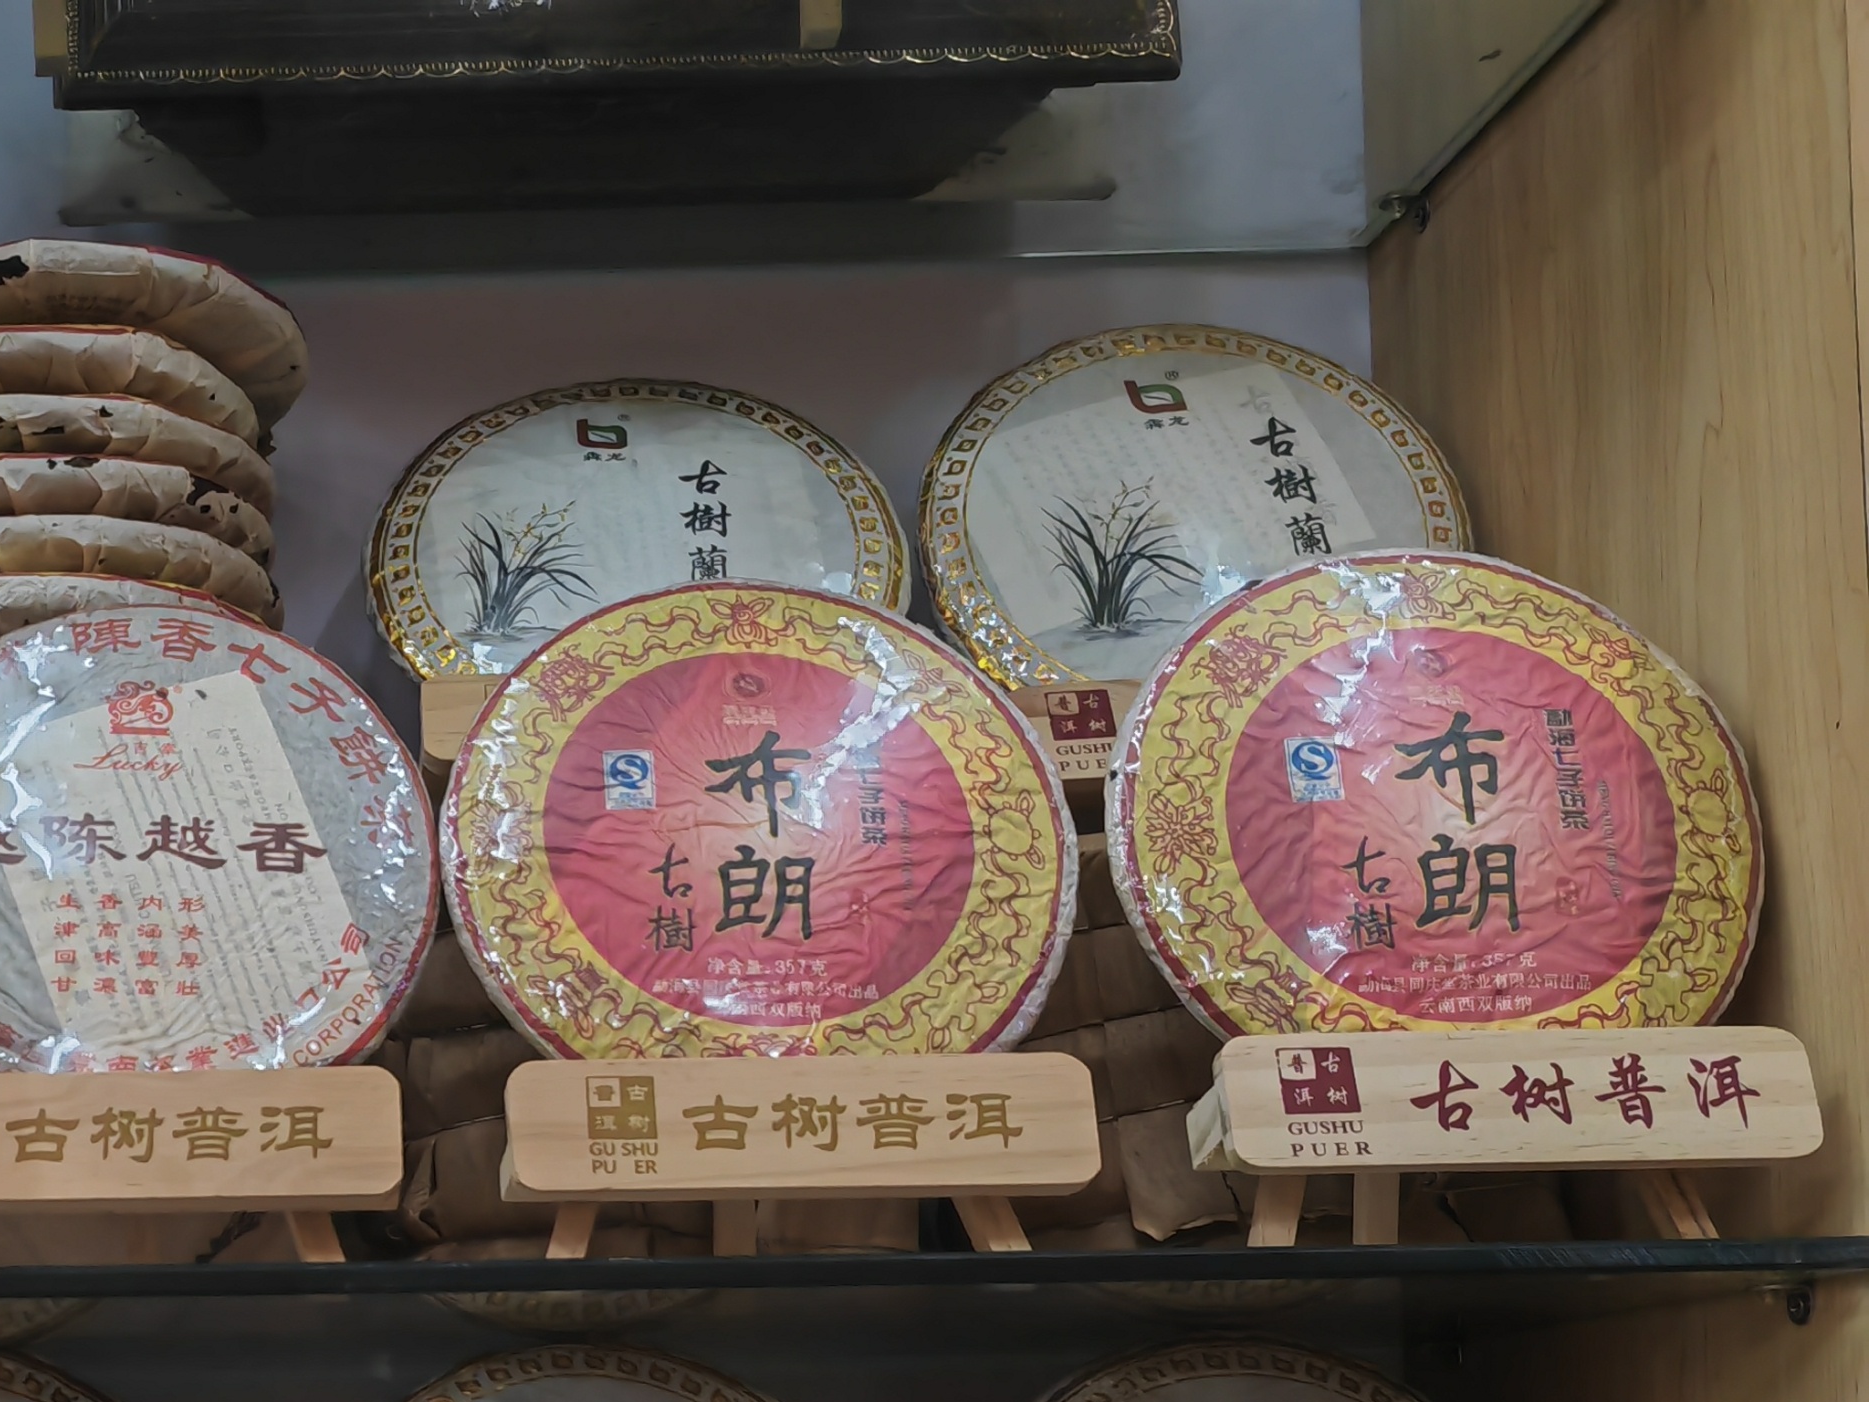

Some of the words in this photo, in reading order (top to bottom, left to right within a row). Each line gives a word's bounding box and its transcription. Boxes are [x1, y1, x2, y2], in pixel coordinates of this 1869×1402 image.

[73, 743, 184, 781] Lucky
[704, 730, 816, 941] 布朗
[1394, 711, 1520, 932] 布朗
[646, 843, 697, 953] 古樹
[1342, 836, 1396, 950] 古樹
[292, 935, 404, 1069] CORPORATION
[682, 1093, 1023, 1152] 古树普洱
[1410, 1055, 1761, 1132] 古树普洱
[5, 1106, 333, 1164] 古树普洱
[589, 1142, 616, 1156] GU
[621, 1142, 659, 1156] SHU
[1288, 1121, 1364, 1136] GUSHU
[1290, 1142, 1372, 1158] PUER
[592, 1160, 617, 1174] PU
[634, 1160, 658, 1174] ER
